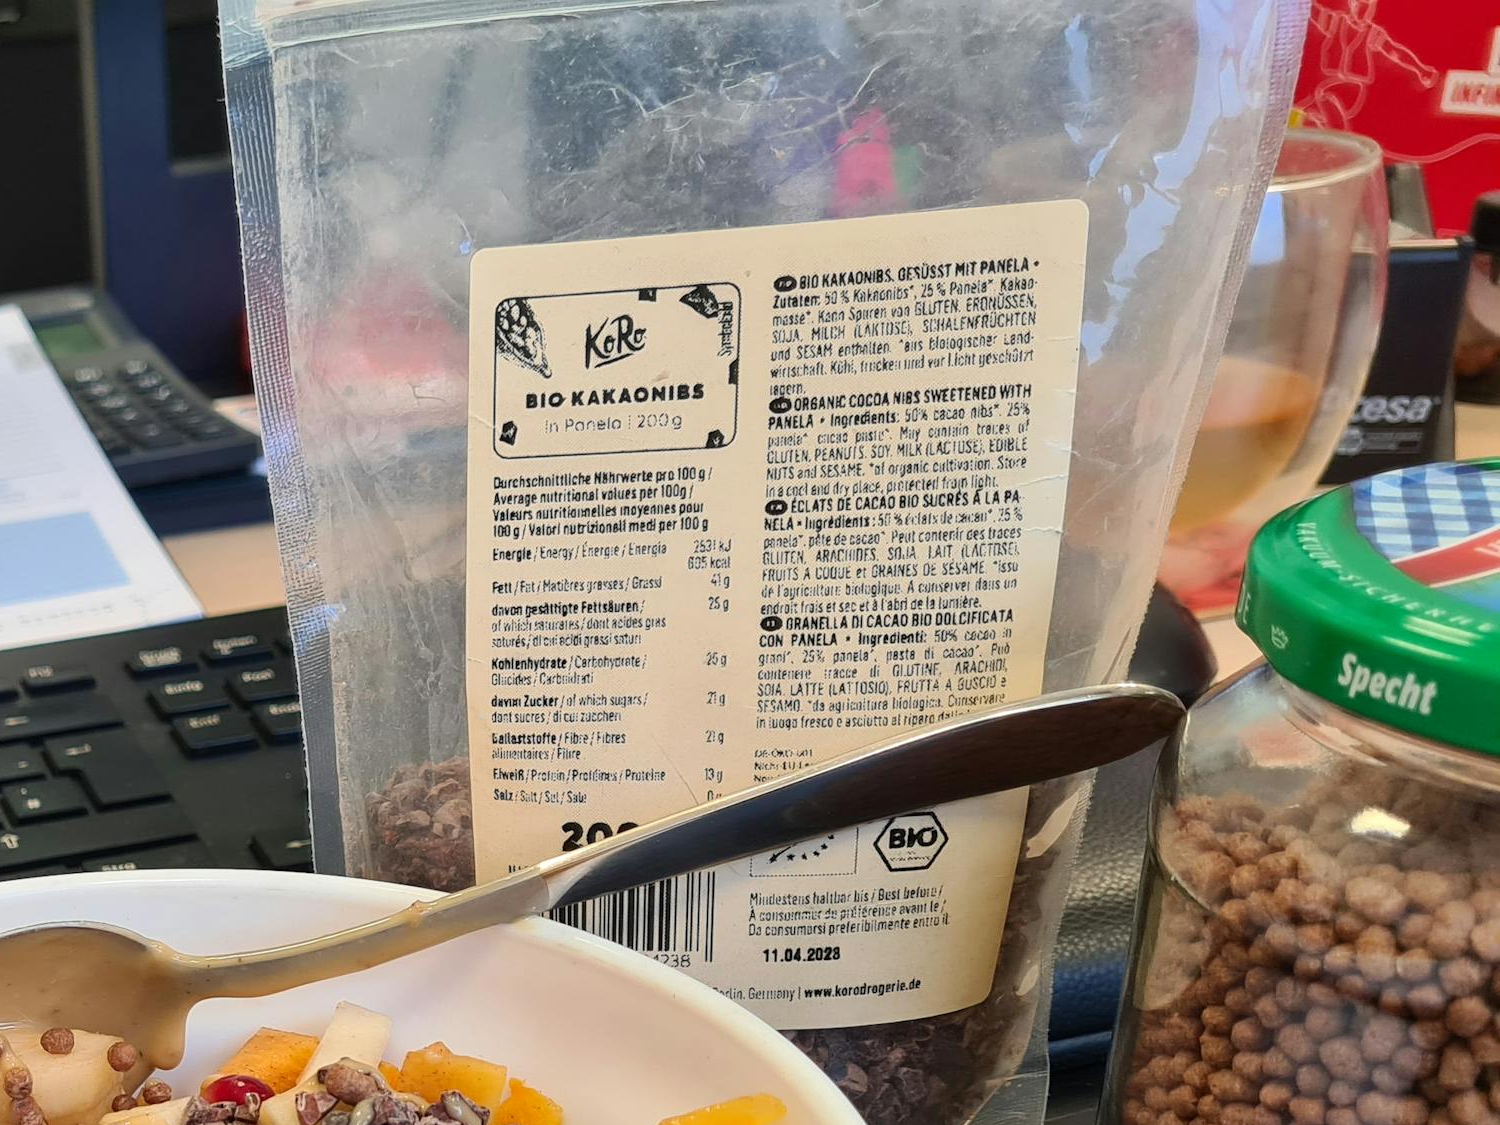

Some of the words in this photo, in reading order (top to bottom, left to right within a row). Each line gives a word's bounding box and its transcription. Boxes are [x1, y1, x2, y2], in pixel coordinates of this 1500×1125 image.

[799, 273, 819, 290] BIO
[954, 260, 977, 277] MIT
[979, 257, 1029, 275] PANELA
[584, 314, 647, 370] KoRo
[525, 392, 566, 409] BIO
[571, 383, 704, 407] KAKAONIBS
[793, 394, 847, 412] ORGANIC
[848, 392, 890, 408] COCOA
[893, 390, 921, 405] NIBS
[923, 385, 997, 404] SWEETENED
[999, 383, 1032, 400] WITH
[565, 416, 622, 433] Panela
[768, 413, 814, 431] PANELA
[593, 470, 653, 485] Nährwerte
[493, 492, 538, 507] Average
[540, 487, 599, 504] nutritional
[601, 487, 637, 501] values
[639, 487, 658, 502] per
[790, 496, 833, 514] ÉCLATS
[836, 497, 852, 512] DE
[855, 495, 896, 511] CACAO
[899, 494, 920, 509] BIO
[985, 490, 1000, 505] LA
[492, 508, 533, 522] Valeurs
[535, 503, 617, 520] nutritionnelles
[620, 503, 677, 519] moyennes
[678, 503, 704, 516] pour
[563, 519, 627, 536] nutrizionali
[628, 518, 657, 533] medi
[658, 520, 678, 534] per
[764, 516, 794, 532] NELA
[492, 547, 532, 563] Energie
[785, 615, 848, 631] GRANELLA
[851, 614, 863, 629] DI
[866, 613, 909, 628] CACAO
[911, 613, 933, 627] BIO
[935, 608, 1014, 627] DOLCIFICATA
[758, 634, 784, 648] CON
[791, 632, 838, 647] PANELA
[491, 656, 568, 672] Kohlenhydrate
[1338, 652, 1437, 716] Specht
[523, 694, 559, 708] Zucker
[800, 715, 834, 729] fresco
[889, 827, 938, 849] BIO
[804, 978, 921, 998] www.korodrogerie.de
